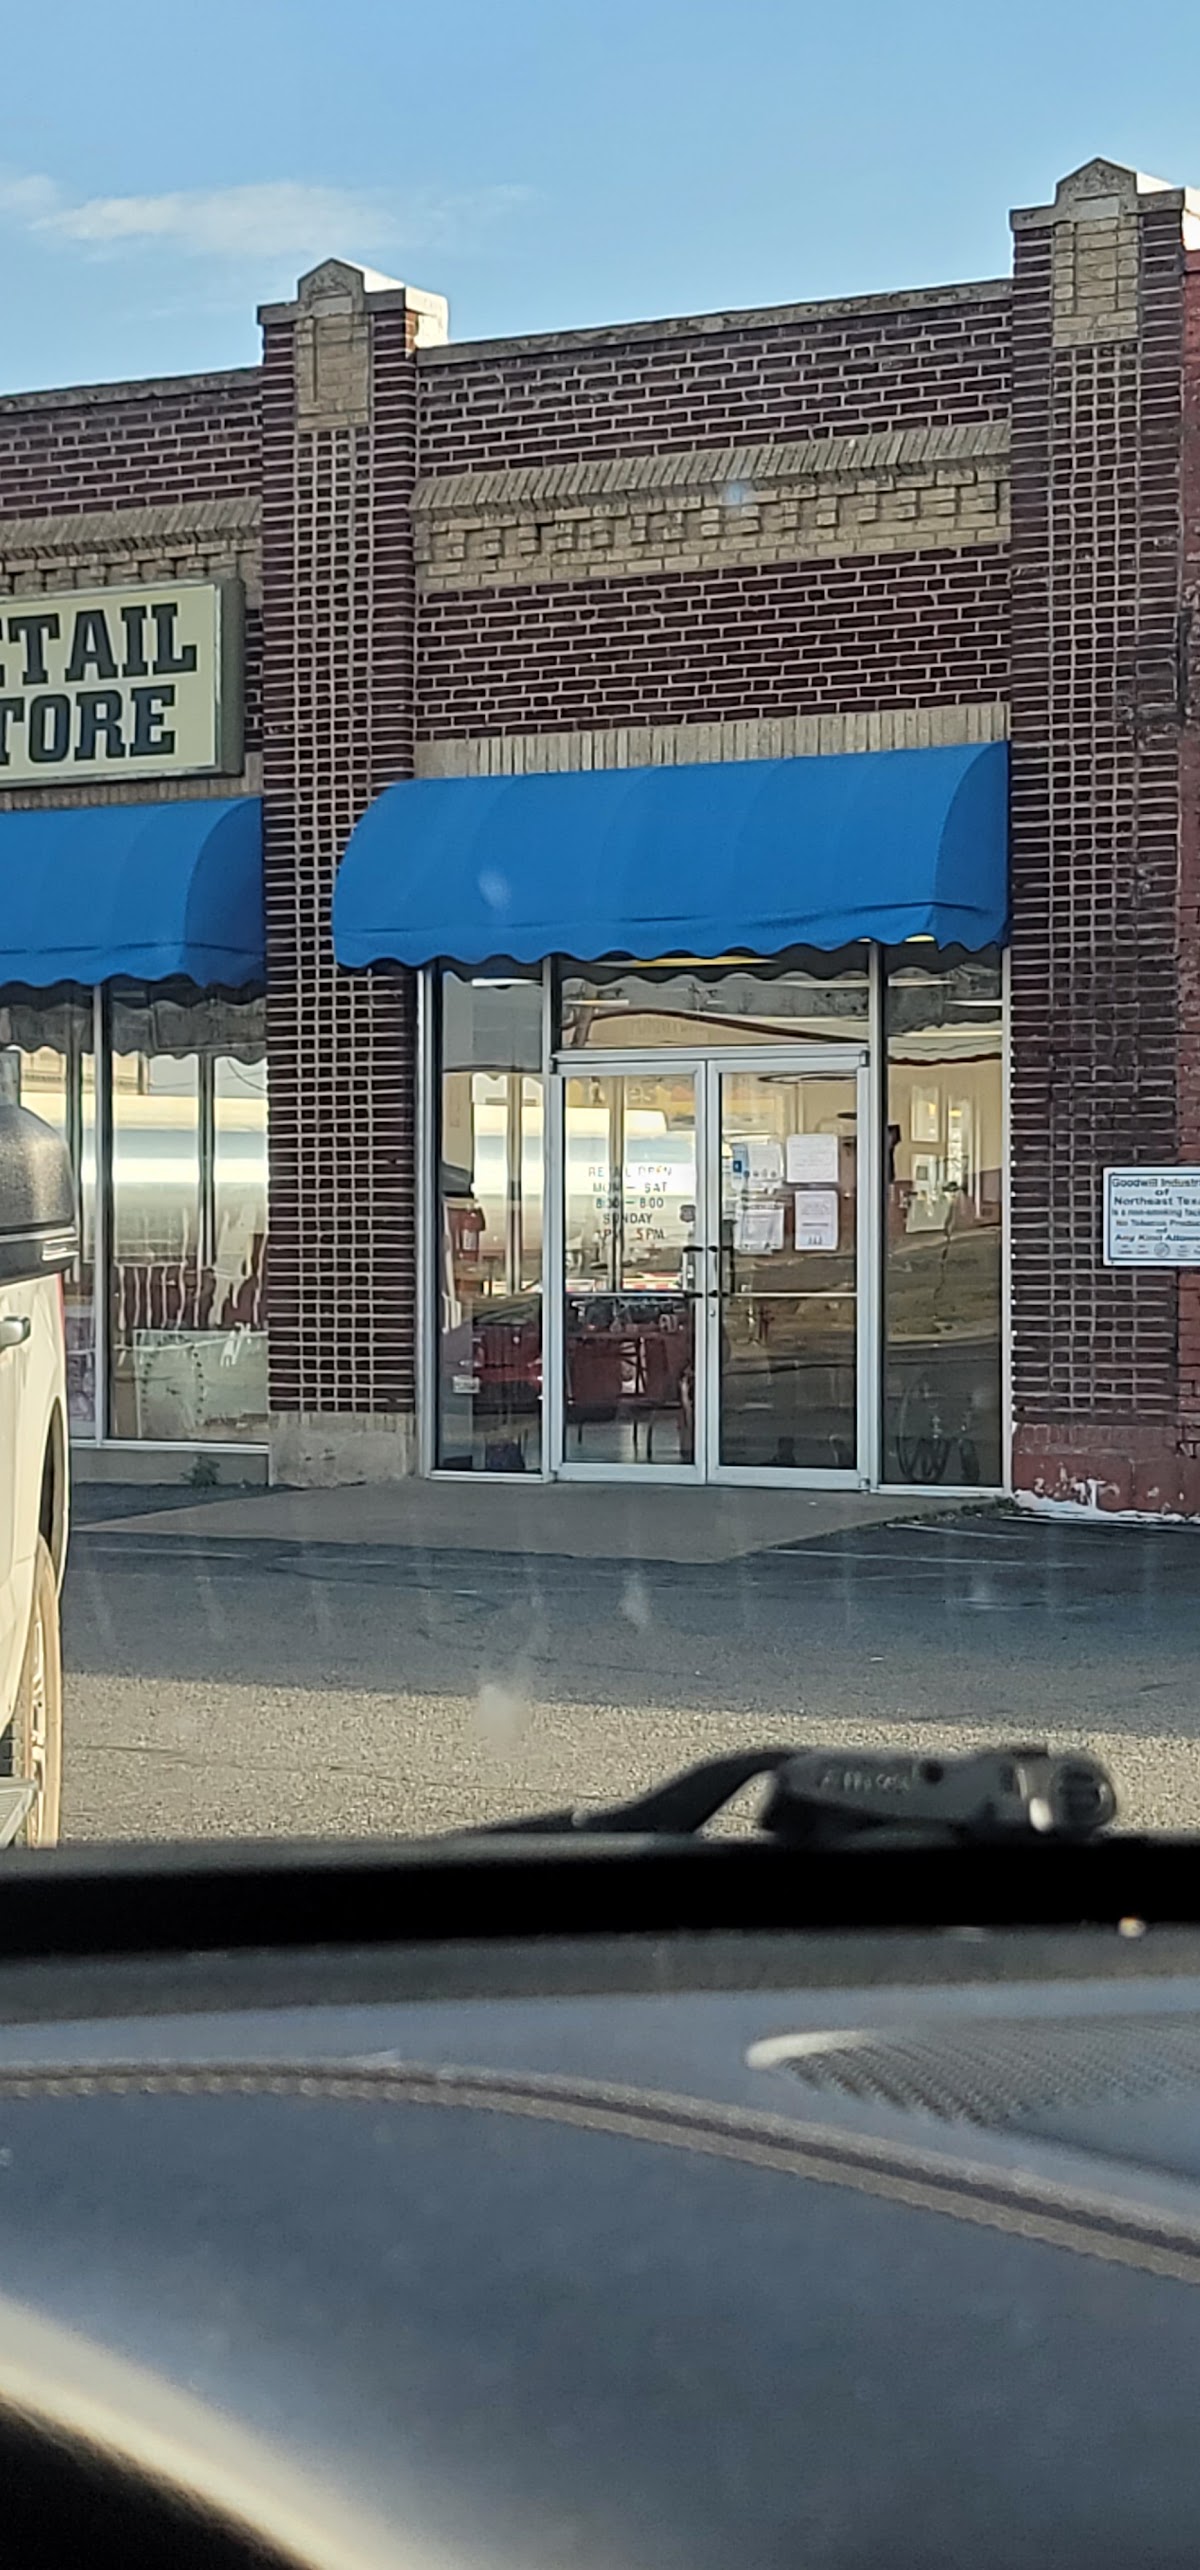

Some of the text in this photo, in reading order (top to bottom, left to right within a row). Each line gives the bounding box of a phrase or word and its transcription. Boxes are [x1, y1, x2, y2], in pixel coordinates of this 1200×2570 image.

[0, 602, 197, 686] TAIL
[588, 1166, 632, 1178] REAL
[645, 1181, 668, 1194] SAT
[1112, 1178, 1158, 1187] Goodwill
[1114, 1196, 1173, 1206] Northeast
[603, 1213, 653, 1225] SUNDAY
